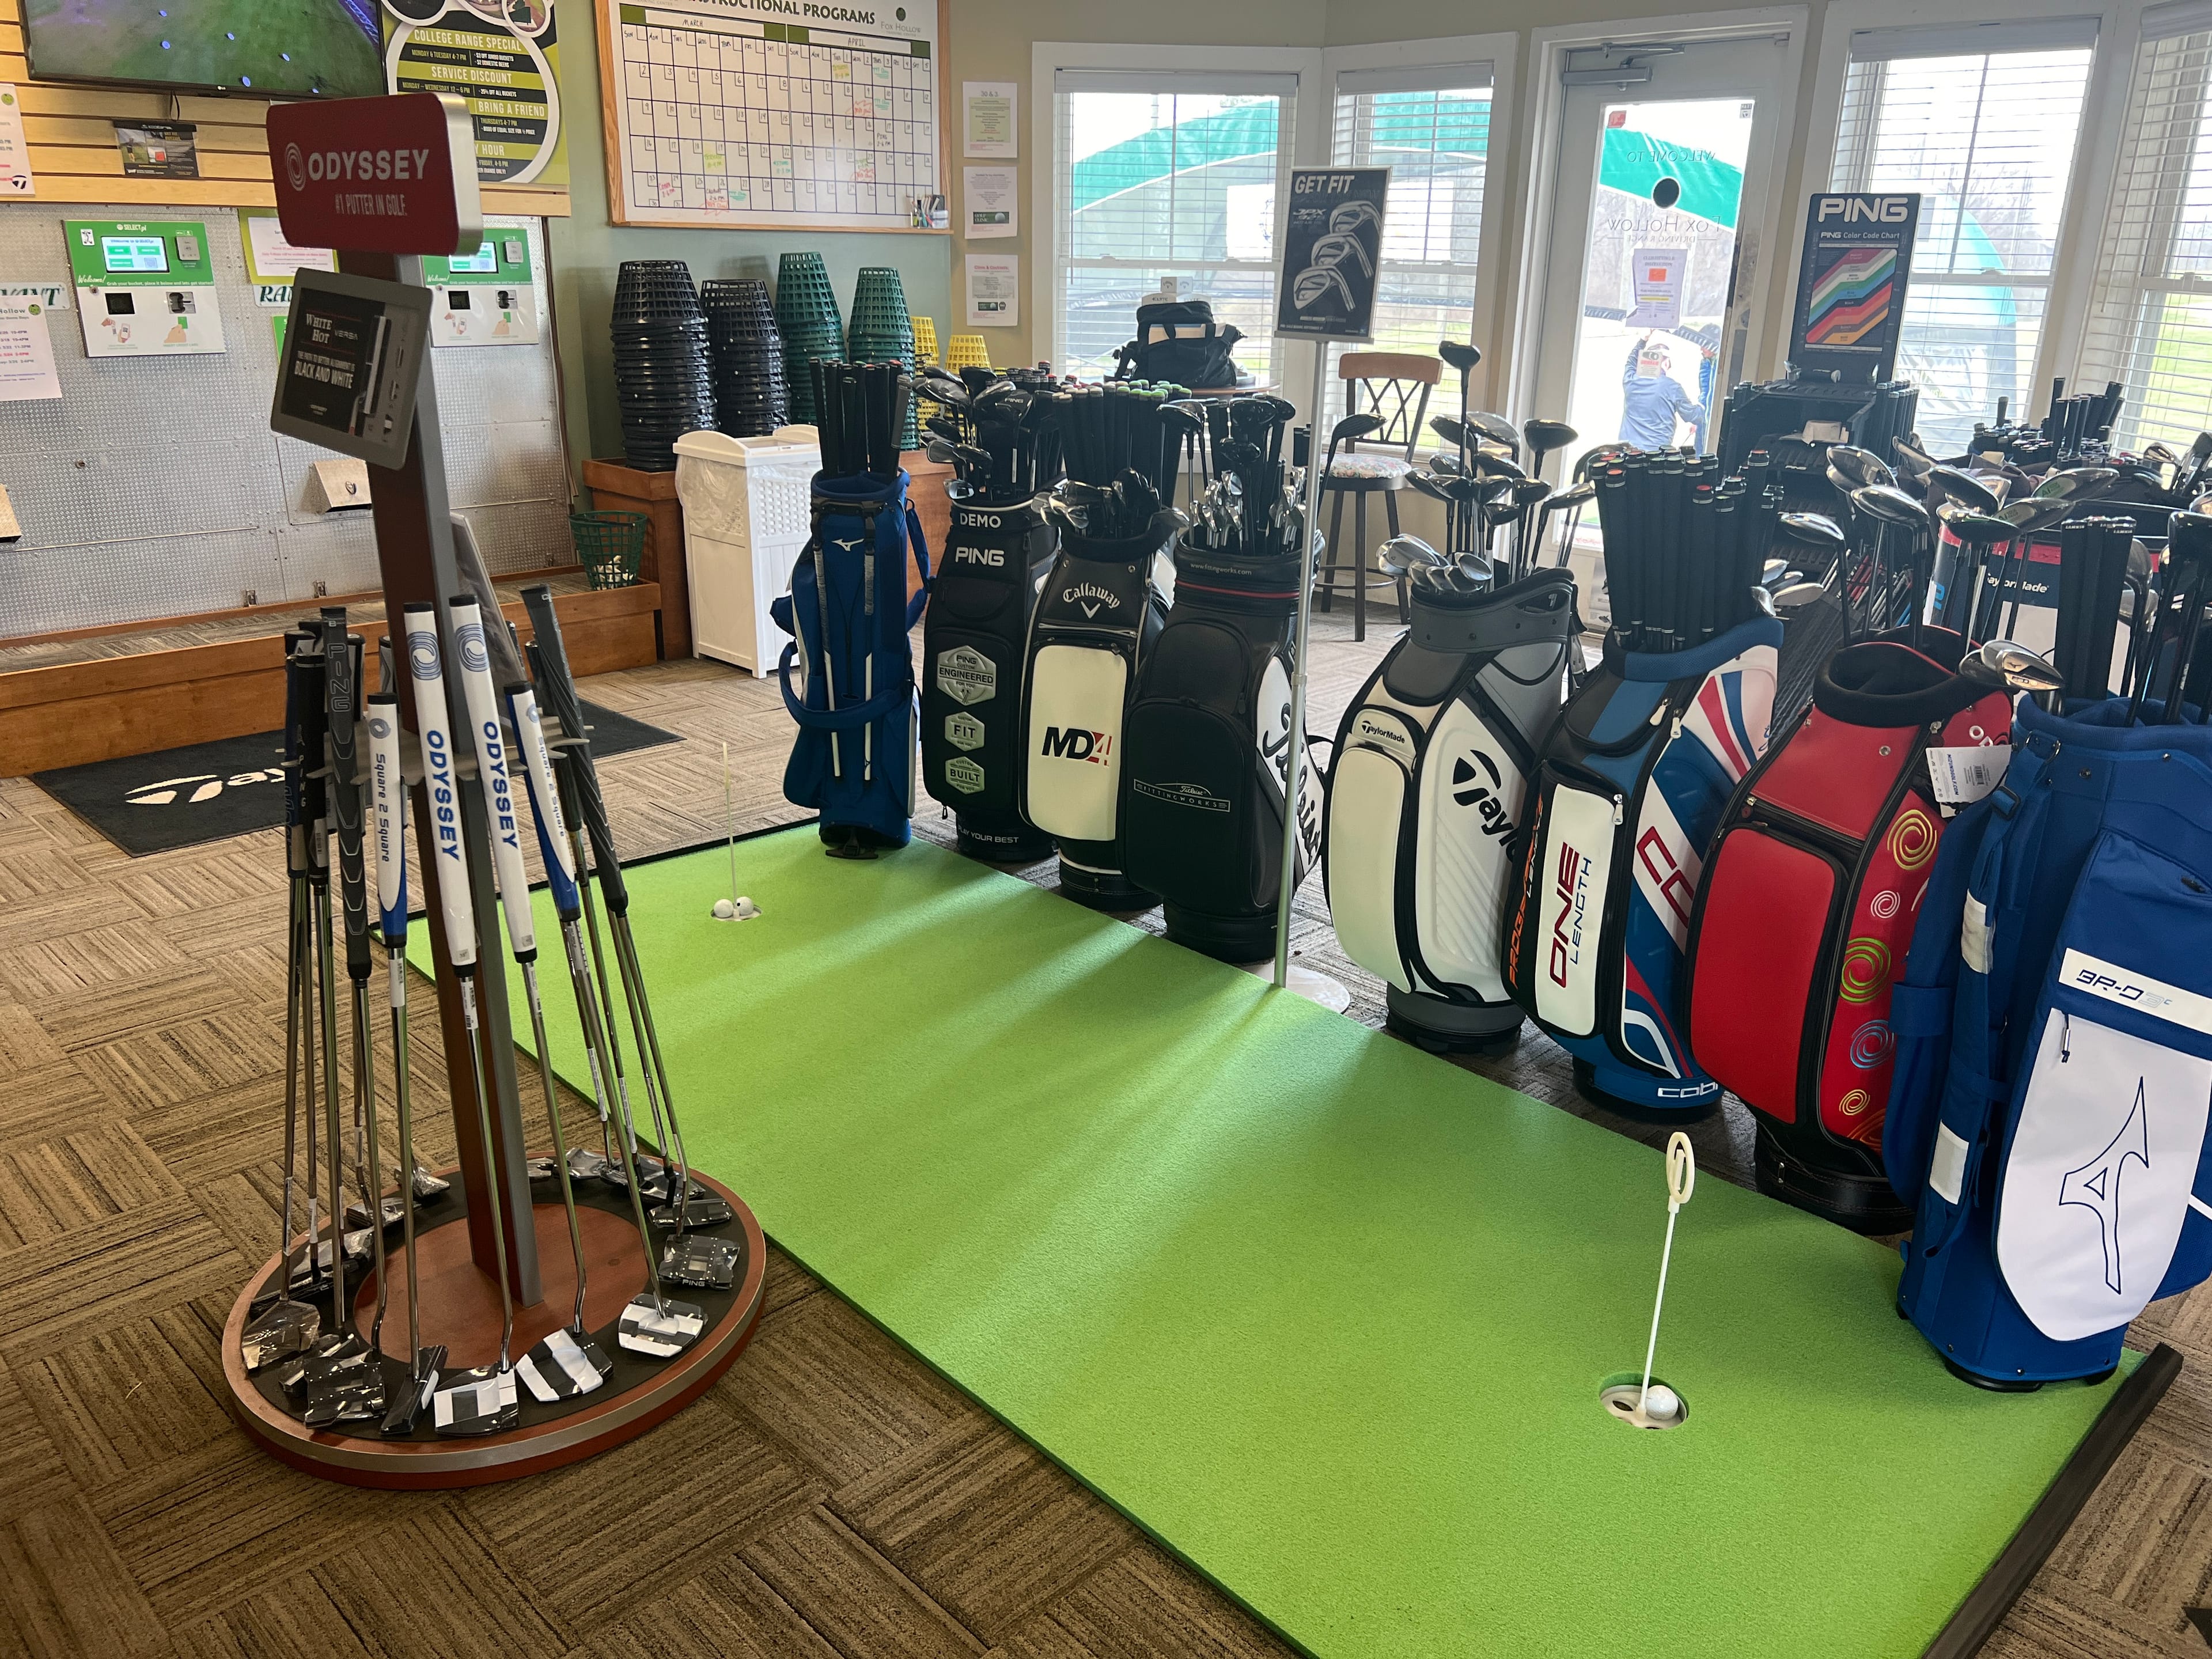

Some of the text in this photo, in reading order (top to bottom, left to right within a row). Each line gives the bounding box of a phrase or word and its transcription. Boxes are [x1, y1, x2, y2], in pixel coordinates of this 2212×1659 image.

[682, 18, 703, 28] MARCH
[803, 3, 875, 25] PROGRAMS
[414, 29, 522, 51] COLLEGE RANGE SPECIAL
[847, 37, 866, 47] APRIL
[434, 51, 452, 59] TUESDAY
[431, 66, 512, 85] SERVICE DISCOUNT
[641, 66, 646, 75] 2
[691, 69, 696, 78] 4
[714, 71, 719, 80] 5
[737, 75, 742, 84] 6
[759, 77, 764, 85] 7
[782, 79, 787, 88] 8
[425, 84, 449, 92] WEDNESDAY
[867, 87, 870, 96] 9
[478, 101, 545, 117] BRING A FRIEND
[645, 103, 649, 111] 9
[669, 105, 675, 113] 10
[738, 110, 745, 119] 13
[760, 112, 767, 120] 14
[782, 114, 788, 122] 15
[847, 118, 852, 126] 15
[482, 144, 505, 156] HOUR
[784, 147, 790, 156] 22
[308, 149, 430, 181] ODYSSEY
[742, 179, 748, 187] 27
[764, 180, 770, 188] 28
[786, 180, 791, 189] 29
[1294, 175, 1355, 194] GET FIT
[335, 194, 344, 215] #1
[346, 194, 374, 215] PUTTER
[376, 194, 385, 215] IN
[1817, 198, 1908, 222] PING
[78, 274, 107, 284] Welcome!
[305, 313, 333, 331] WHITE
[312, 329, 359, 344] HOT VERSA
[294, 360, 354, 389] BLACK AND WHITE
[959, 513, 1002, 529] DEMO
[955, 547, 1005, 567] PING
[1190, 563, 1252, 575] www.fittingworks.com
[1063, 582, 1120, 609] Callaway
[956, 655, 977, 665] PING
[327, 643, 351, 713] PING
[939, 667, 994, 684] ENGINEERED
[954, 724, 976, 738] FIT
[1361, 720, 1406, 744] TaylorMade
[1041, 726, 1113, 767] MD4
[950, 768, 980, 782] BUILT
[483, 721, 519, 850] ODYSSEY
[537, 736, 551, 778] Square
[552, 796, 565, 837] Square
[1179, 786, 1204, 796] Titleist
[426, 729, 461, 862] ODYSSEY
[1143, 786, 1217, 808] FITTINGWORKS
[374, 753, 390, 862] Square 2 Square
[971, 832, 993, 842] YOUR
[1549, 841, 1580, 988] ONE
[1570, 857, 1592, 965] LENGTH
[1657, 1082, 1718, 1098] cob
[682, 1279, 706, 1287] PING
